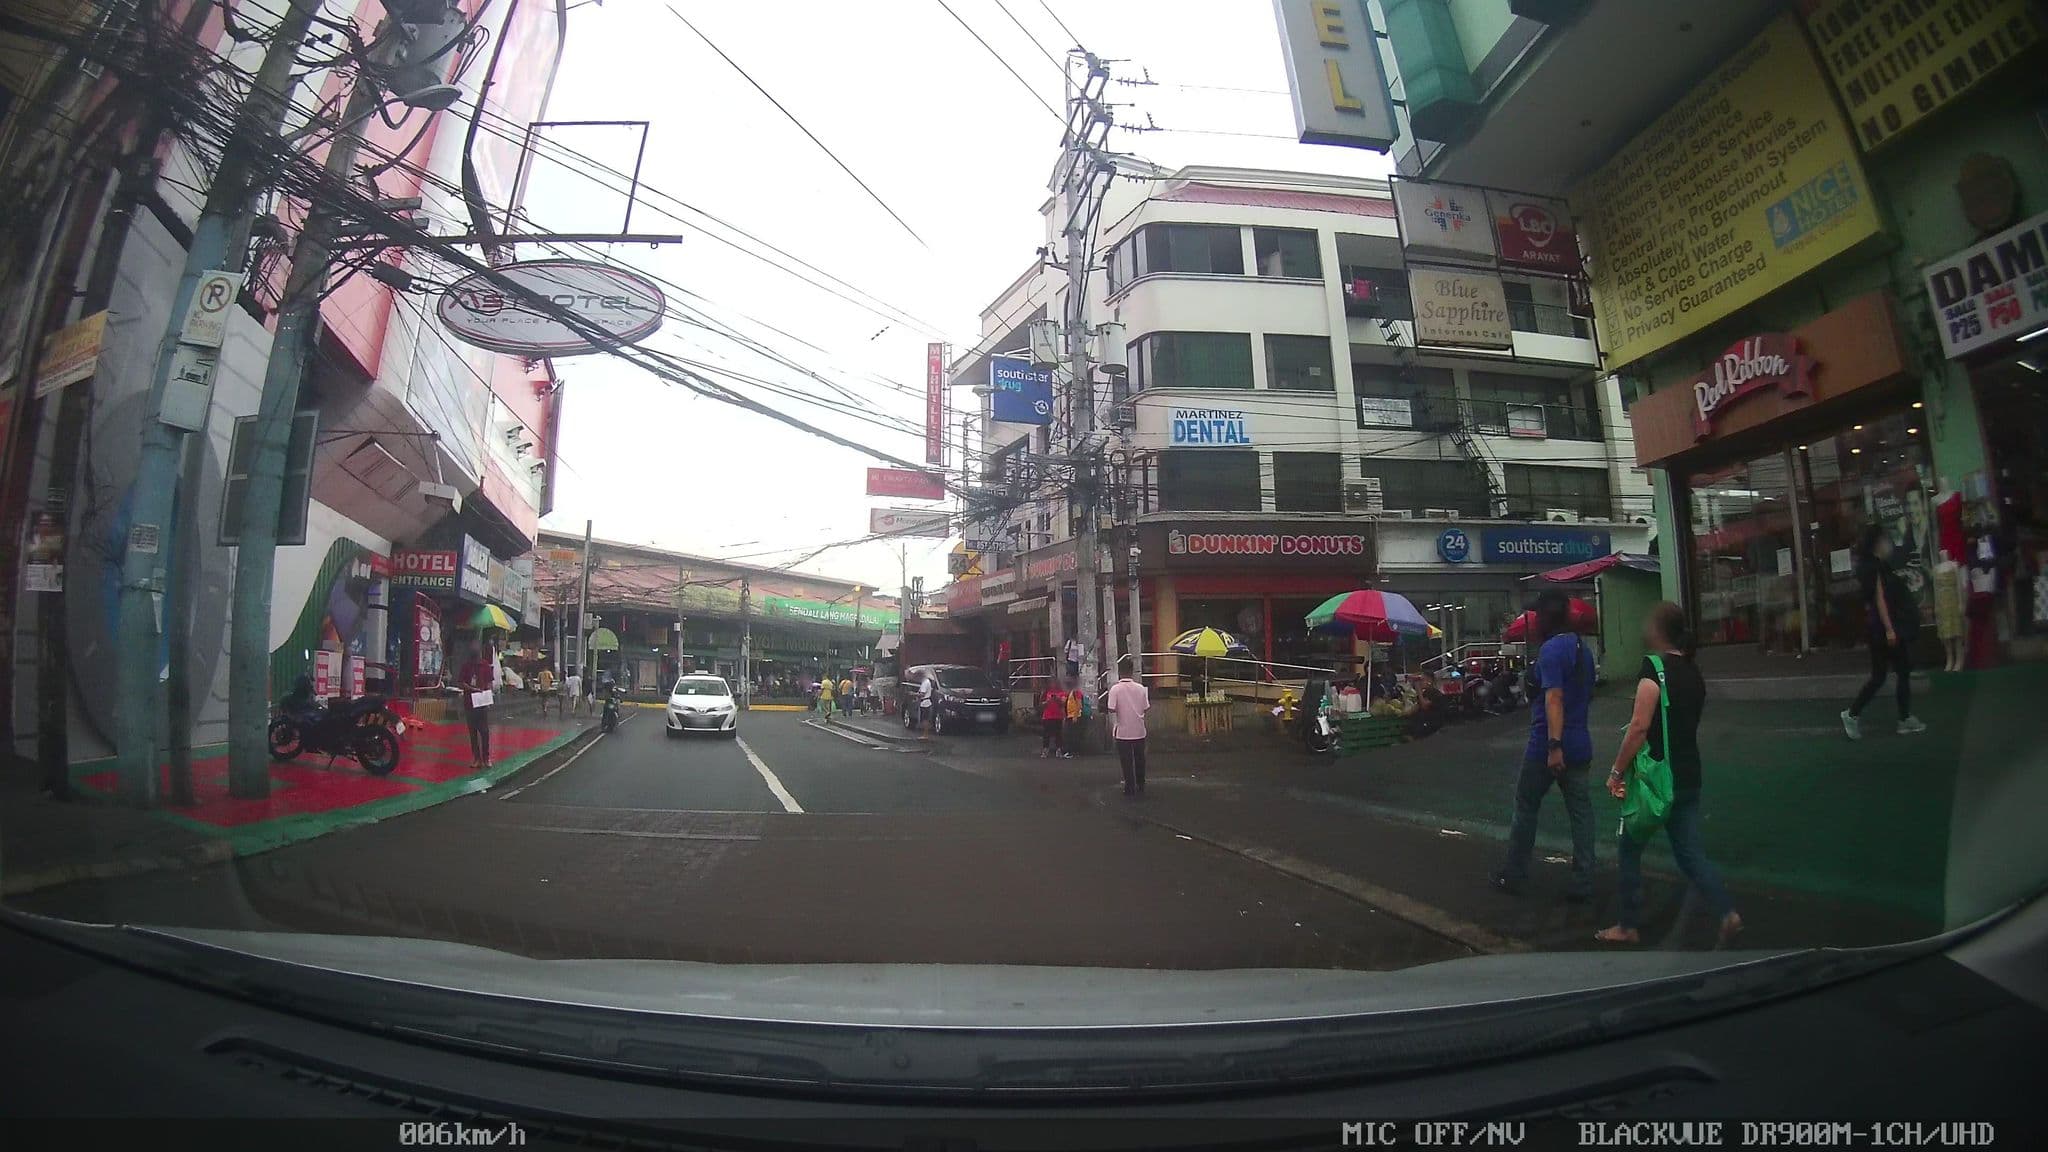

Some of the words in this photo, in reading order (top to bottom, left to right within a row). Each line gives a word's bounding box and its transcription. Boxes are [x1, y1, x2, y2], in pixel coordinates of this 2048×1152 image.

[1831, 26, 1880, 76] FREE
[1846, 21, 1945, 107] MULTIPLE
[1861, 103, 1901, 146] NO
[1654, 149, 1688, 184] Food
[1692, 110, 1742, 155] Service
[1620, 197, 1657, 228] hours
[1660, 154, 1714, 200] Elevator
[1718, 110, 1773, 156] Service
[1608, 228, 1642, 256] Cable
[1646, 208, 1662, 230] TV
[1677, 159, 1738, 208] In-house
[1742, 118, 1796, 162] Movies
[1612, 234, 1656, 272] Central
[1660, 218, 1686, 242] Fire
[1688, 164, 1764, 222] Protection
[1766, 120, 1828, 168] System
[1788, 163, 1852, 219] NICE
[1424, 208, 1471, 222] Generika
[1618, 240, 1684, 290] Absolutely
[1688, 224, 1708, 244] No
[1712, 170, 1786, 228] Brownout
[1522, 250, 1560, 263] ARAYAT
[1620, 283, 1642, 306] Hot
[1645, 276, 1655, 292] &
[1658, 253, 1690, 284] Cold
[1692, 228, 1734, 262] Water
[1435, 279, 1478, 299] Blue
[1624, 306, 1642, 323] No
[1644, 274, 1696, 310] Service
[1698, 240, 1752, 279] Charge
[449, 289, 646, 312] ASOTEL
[1626, 308, 1674, 342] Privacy
[1678, 252, 1766, 312] Guaranteed
[1421, 301, 1504, 325] Sapphire
[1424, 327, 1477, 337] Internet
[1949, 314, 1982, 343] P25
[997, 369, 1049, 383] southstar
[1694, 362, 1728, 421] Red
[1724, 336, 1790, 394] Ribbon
[1176, 410, 1244, 419] MARTINEZ
[1174, 420, 1250, 444] DENTAL
[1188, 534, 1280, 554] DUNKIN'
[1280, 535, 1363, 554] DONUTS
[1445, 535, 1465, 549] 24
[392, 553, 454, 571] HOTEL
[392, 575, 453, 587] ENTRANCE
